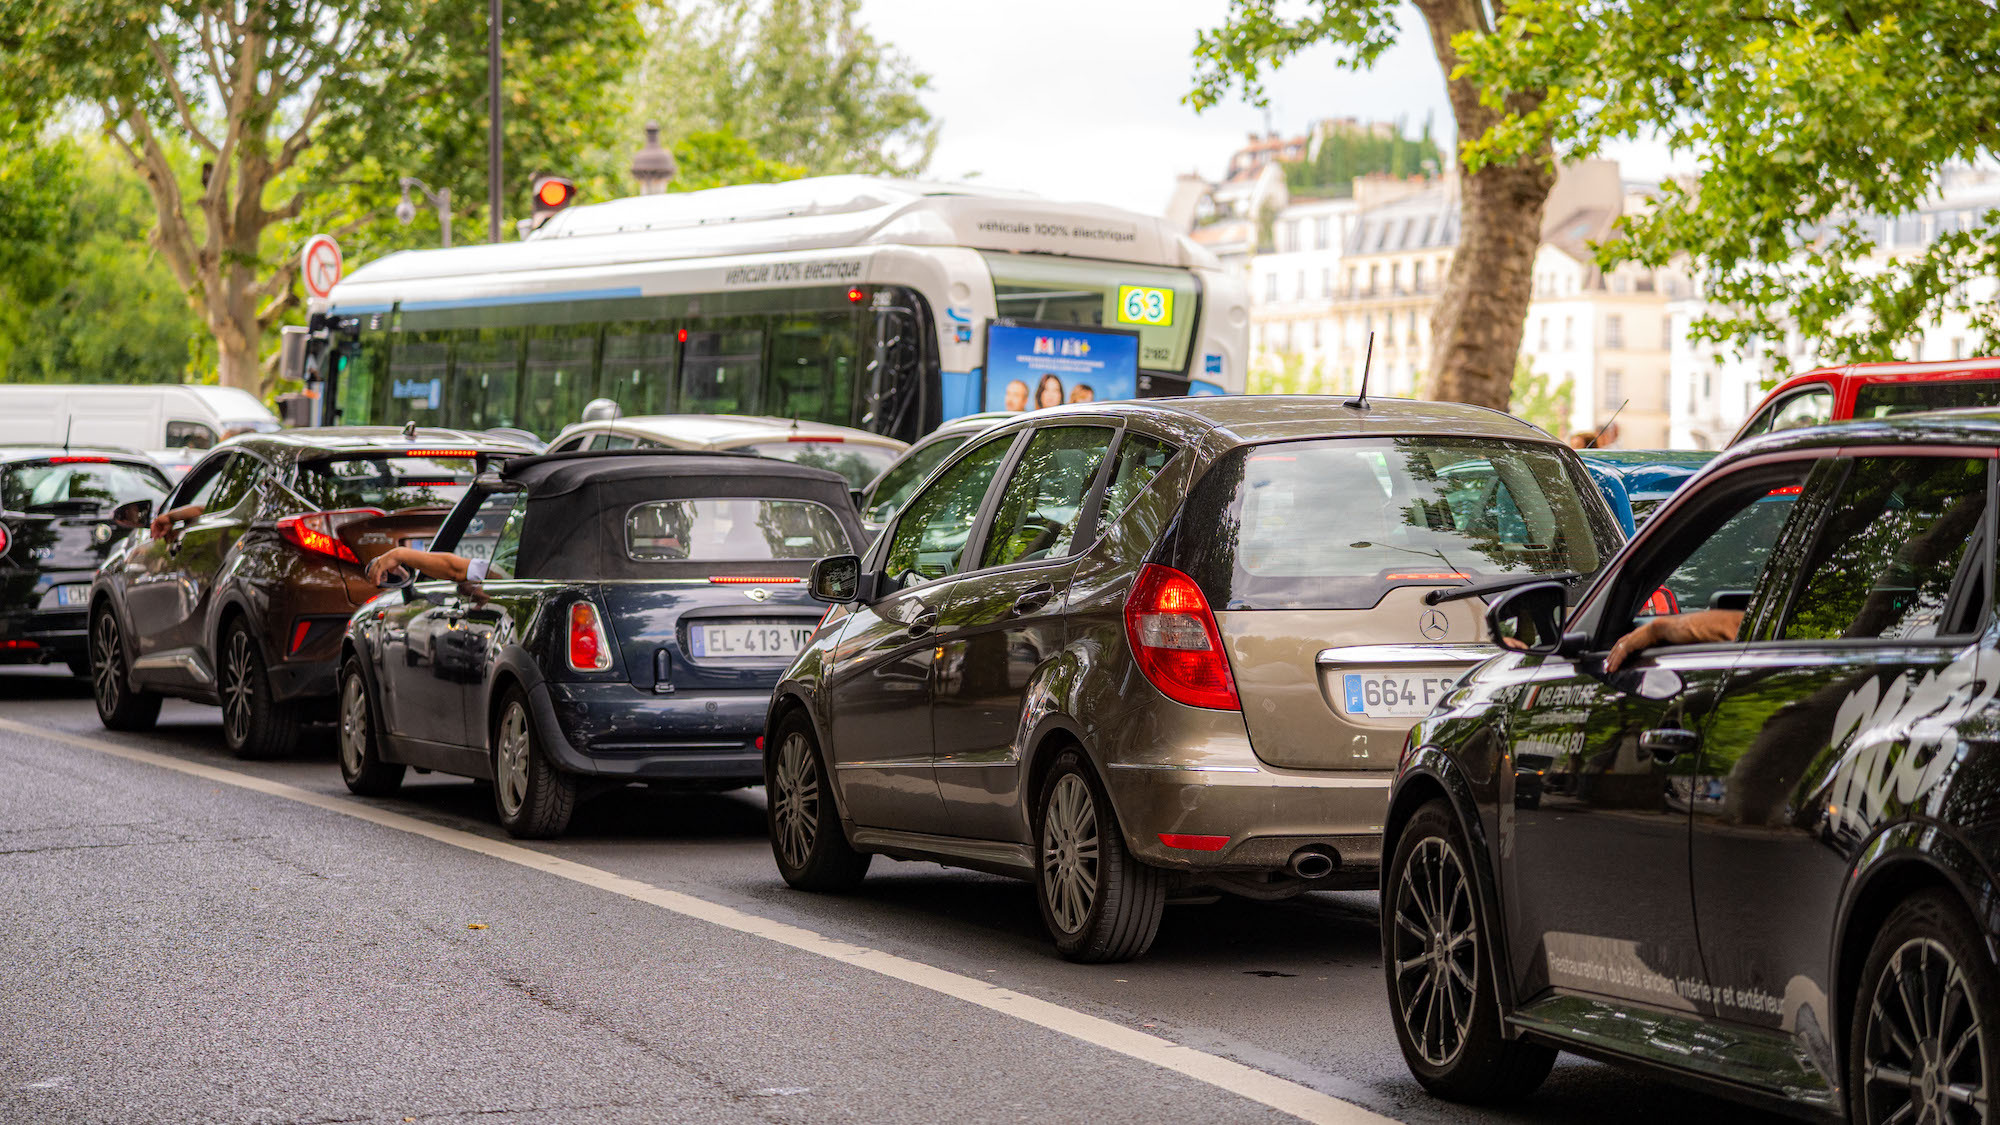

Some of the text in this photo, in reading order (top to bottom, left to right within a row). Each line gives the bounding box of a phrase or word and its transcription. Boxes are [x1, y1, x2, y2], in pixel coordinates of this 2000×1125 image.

[1034, 222, 1068, 237] 100%
[773, 264, 800, 281] 100%
[1125, 288, 1164, 322] 63
[1364, 679, 1416, 706] 664
[1569, 731, 1585, 754] 80
[1548, 951, 1606, 981] Restauration
[1607, 960, 1621, 984] du
[1641, 973, 1676, 996] ancien
[1722, 986, 1736, 1007] et
